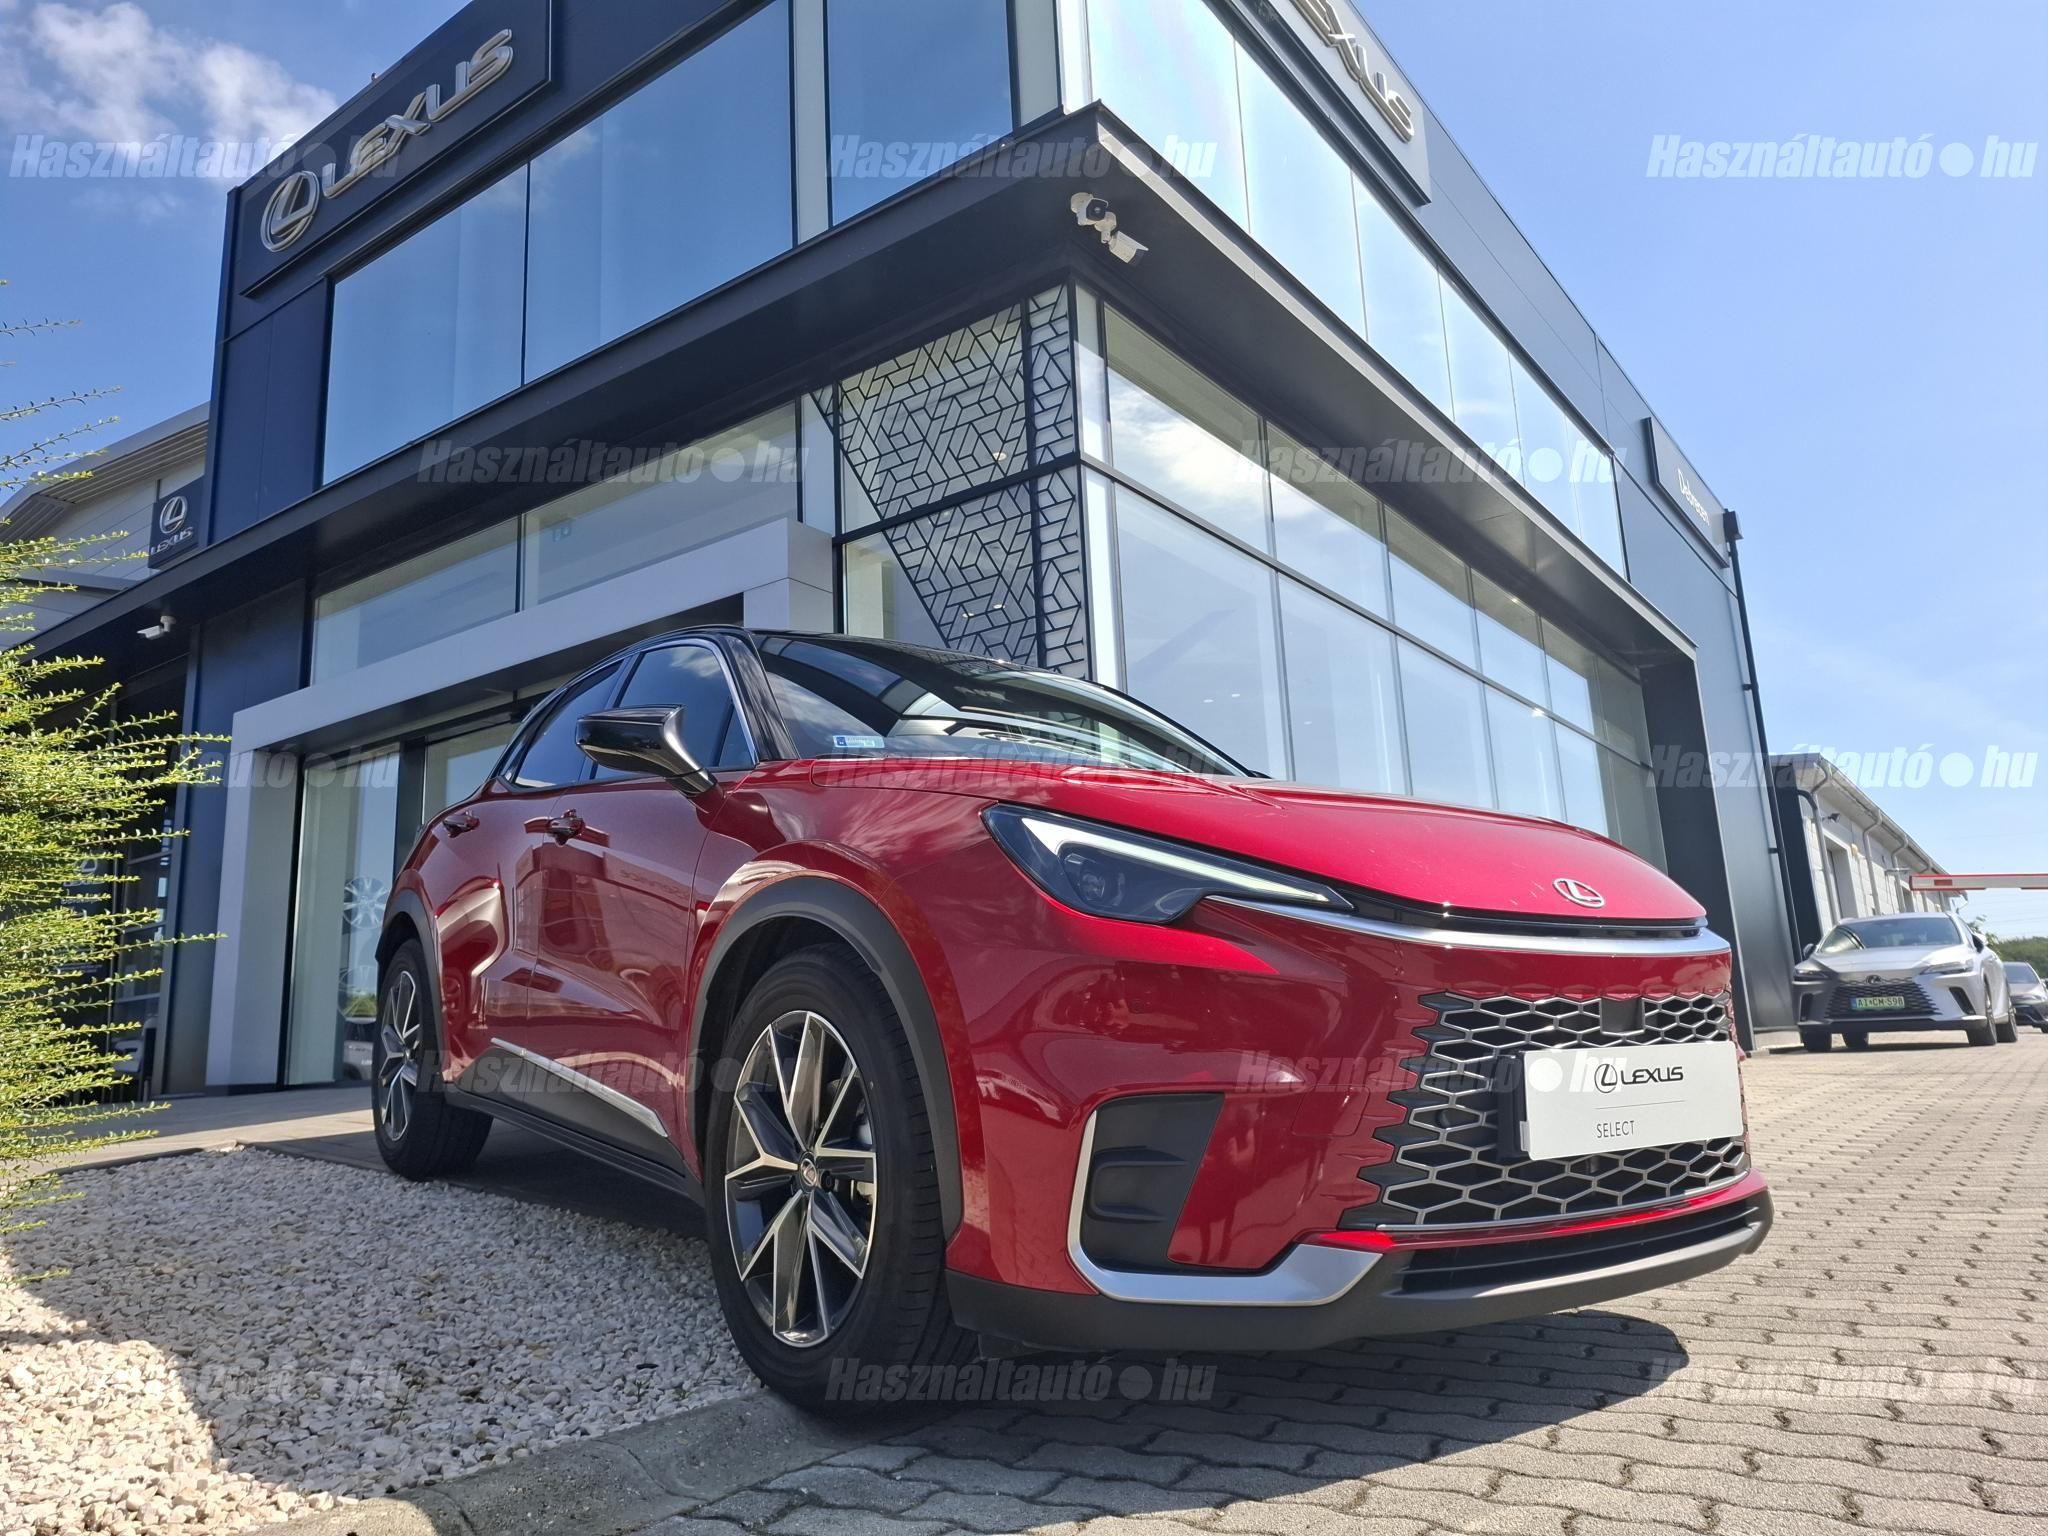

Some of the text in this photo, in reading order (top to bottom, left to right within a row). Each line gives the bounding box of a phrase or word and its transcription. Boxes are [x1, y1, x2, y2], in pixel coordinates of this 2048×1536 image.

[322, 28, 514, 199] LEXUS
[150, 526, 194, 555] LEXUS
[1620, 1066, 1685, 1085] LEXUS
[1596, 1120, 1635, 1139] SELECT
